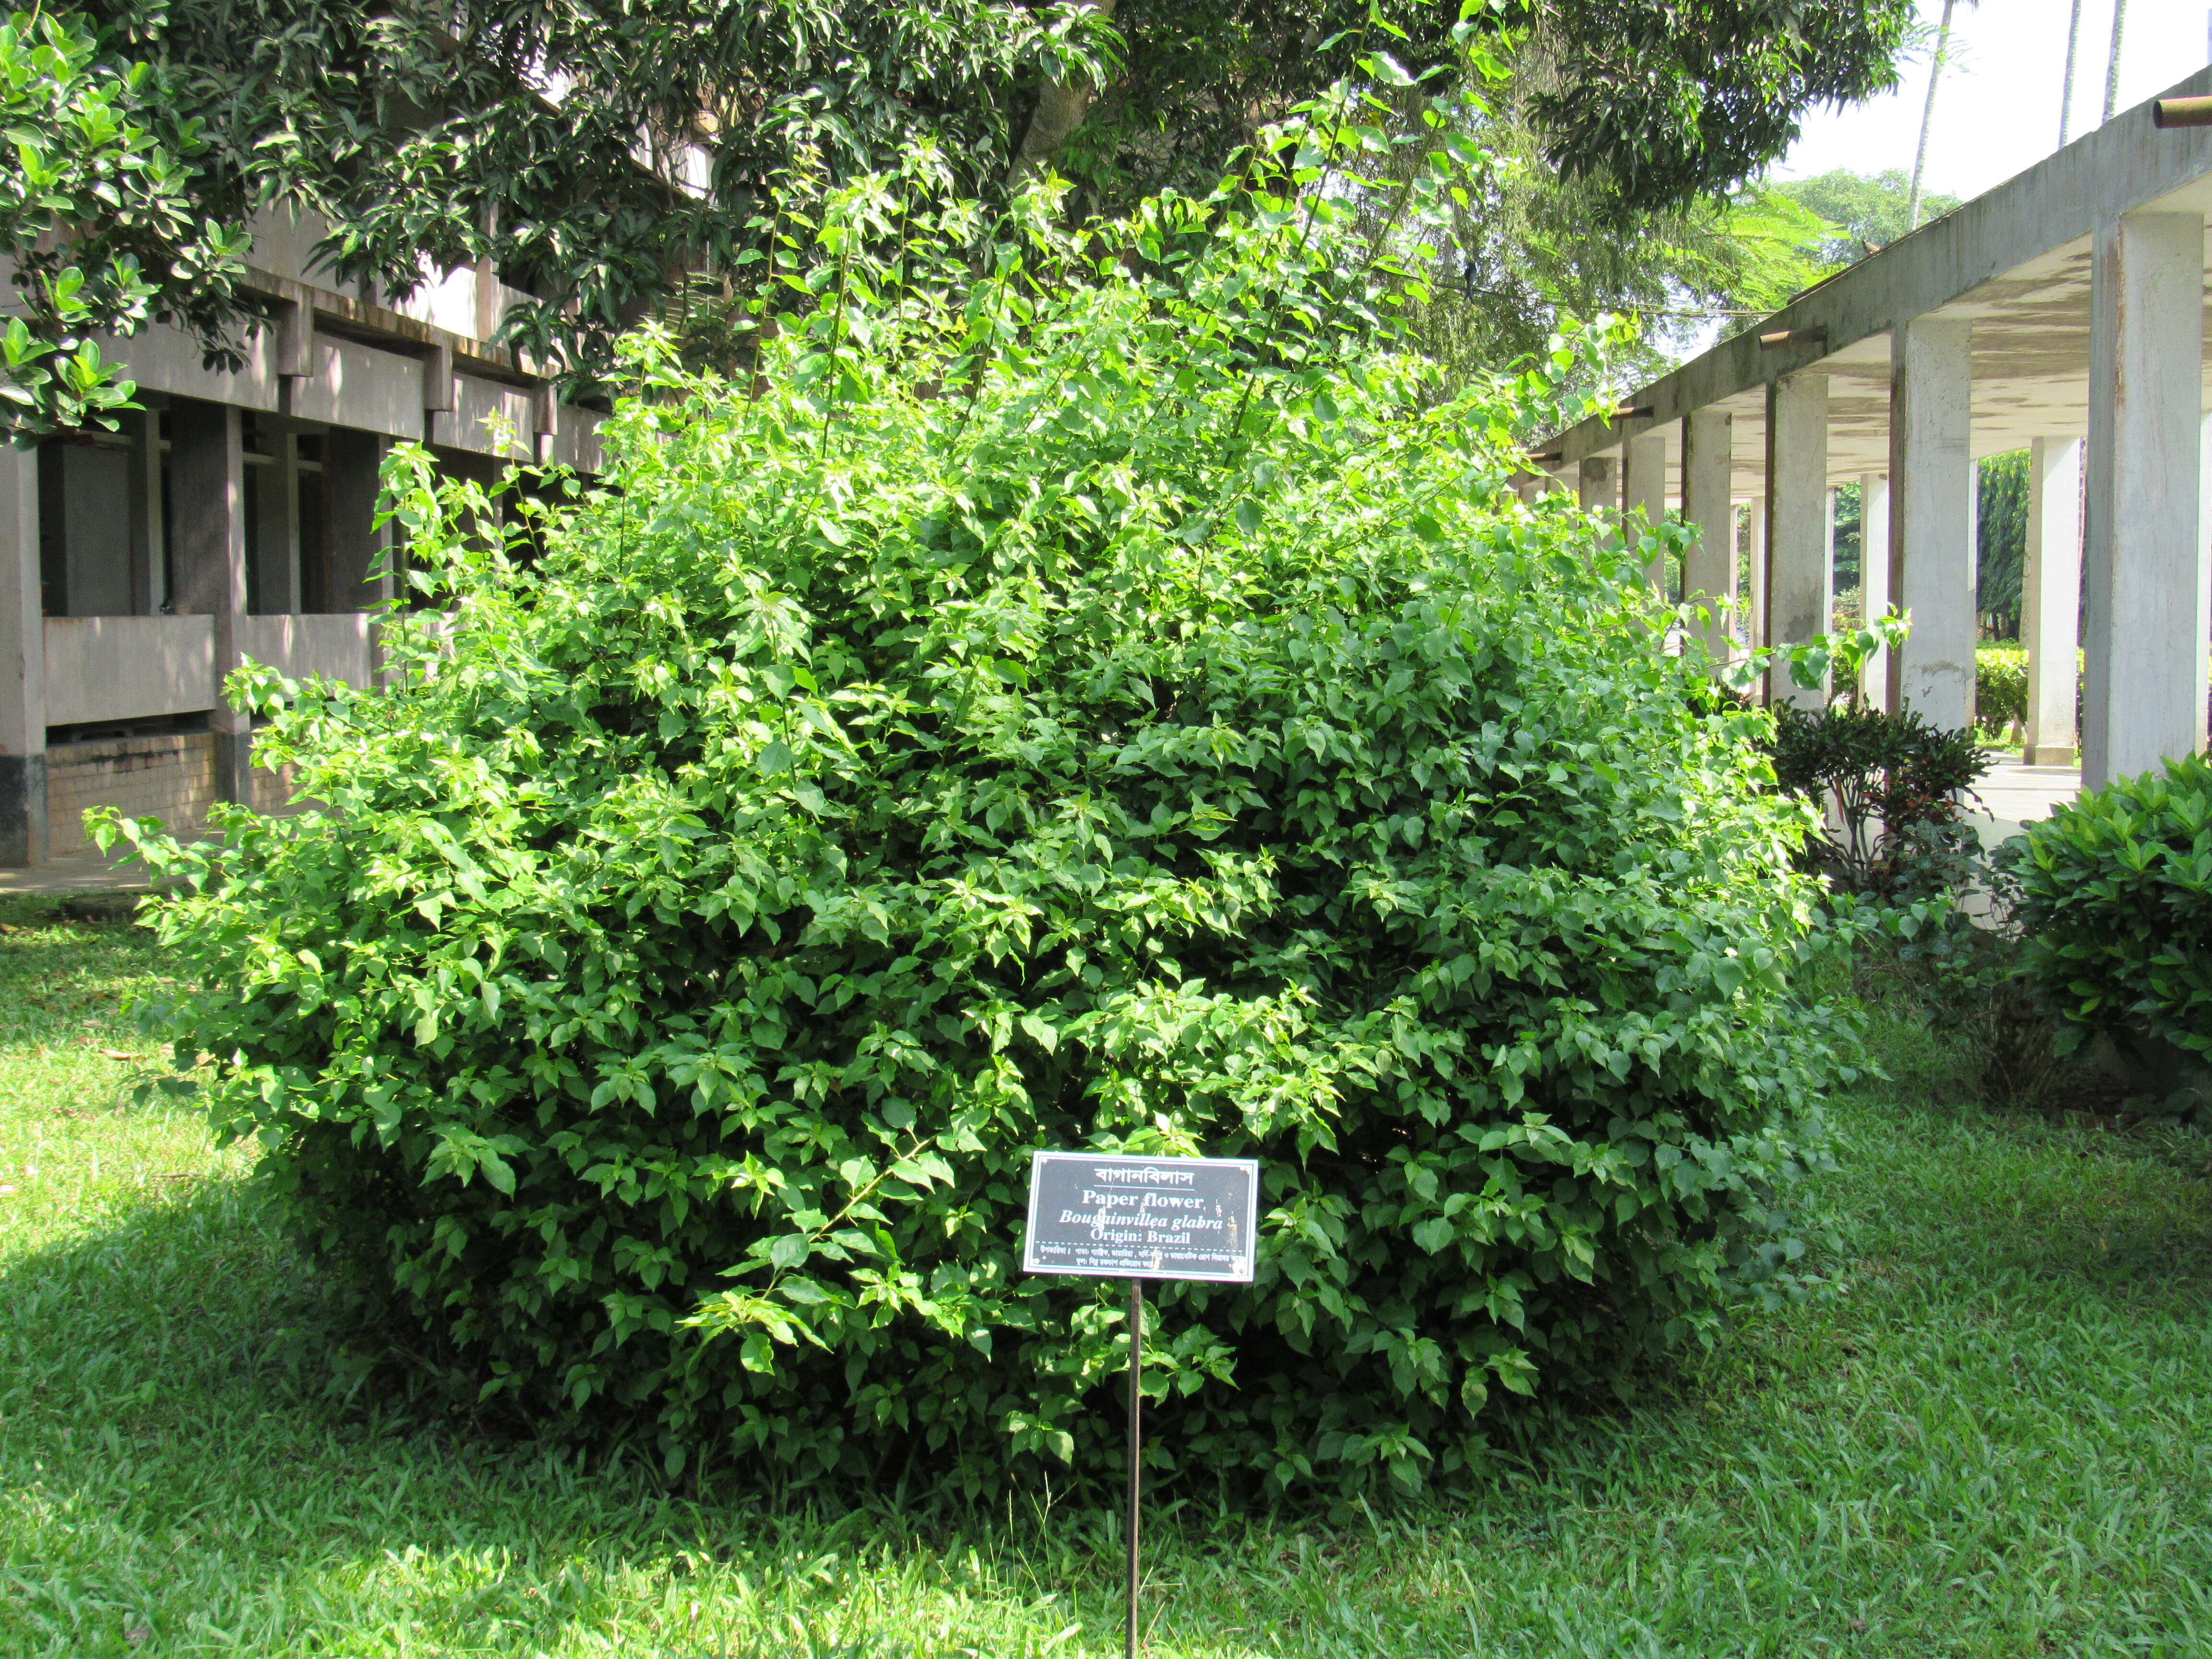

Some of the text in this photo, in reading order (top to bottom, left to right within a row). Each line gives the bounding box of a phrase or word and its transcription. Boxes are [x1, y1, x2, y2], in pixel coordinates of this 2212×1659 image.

[1094, 1167, 1195, 1185] বাগানবিলাস
[1082, 1190, 1139, 1209] Paper
[1058, 1210, 1223, 1230] Bougainvillea glabra
[1090, 1228, 1190, 1244] Origin: Brazil
